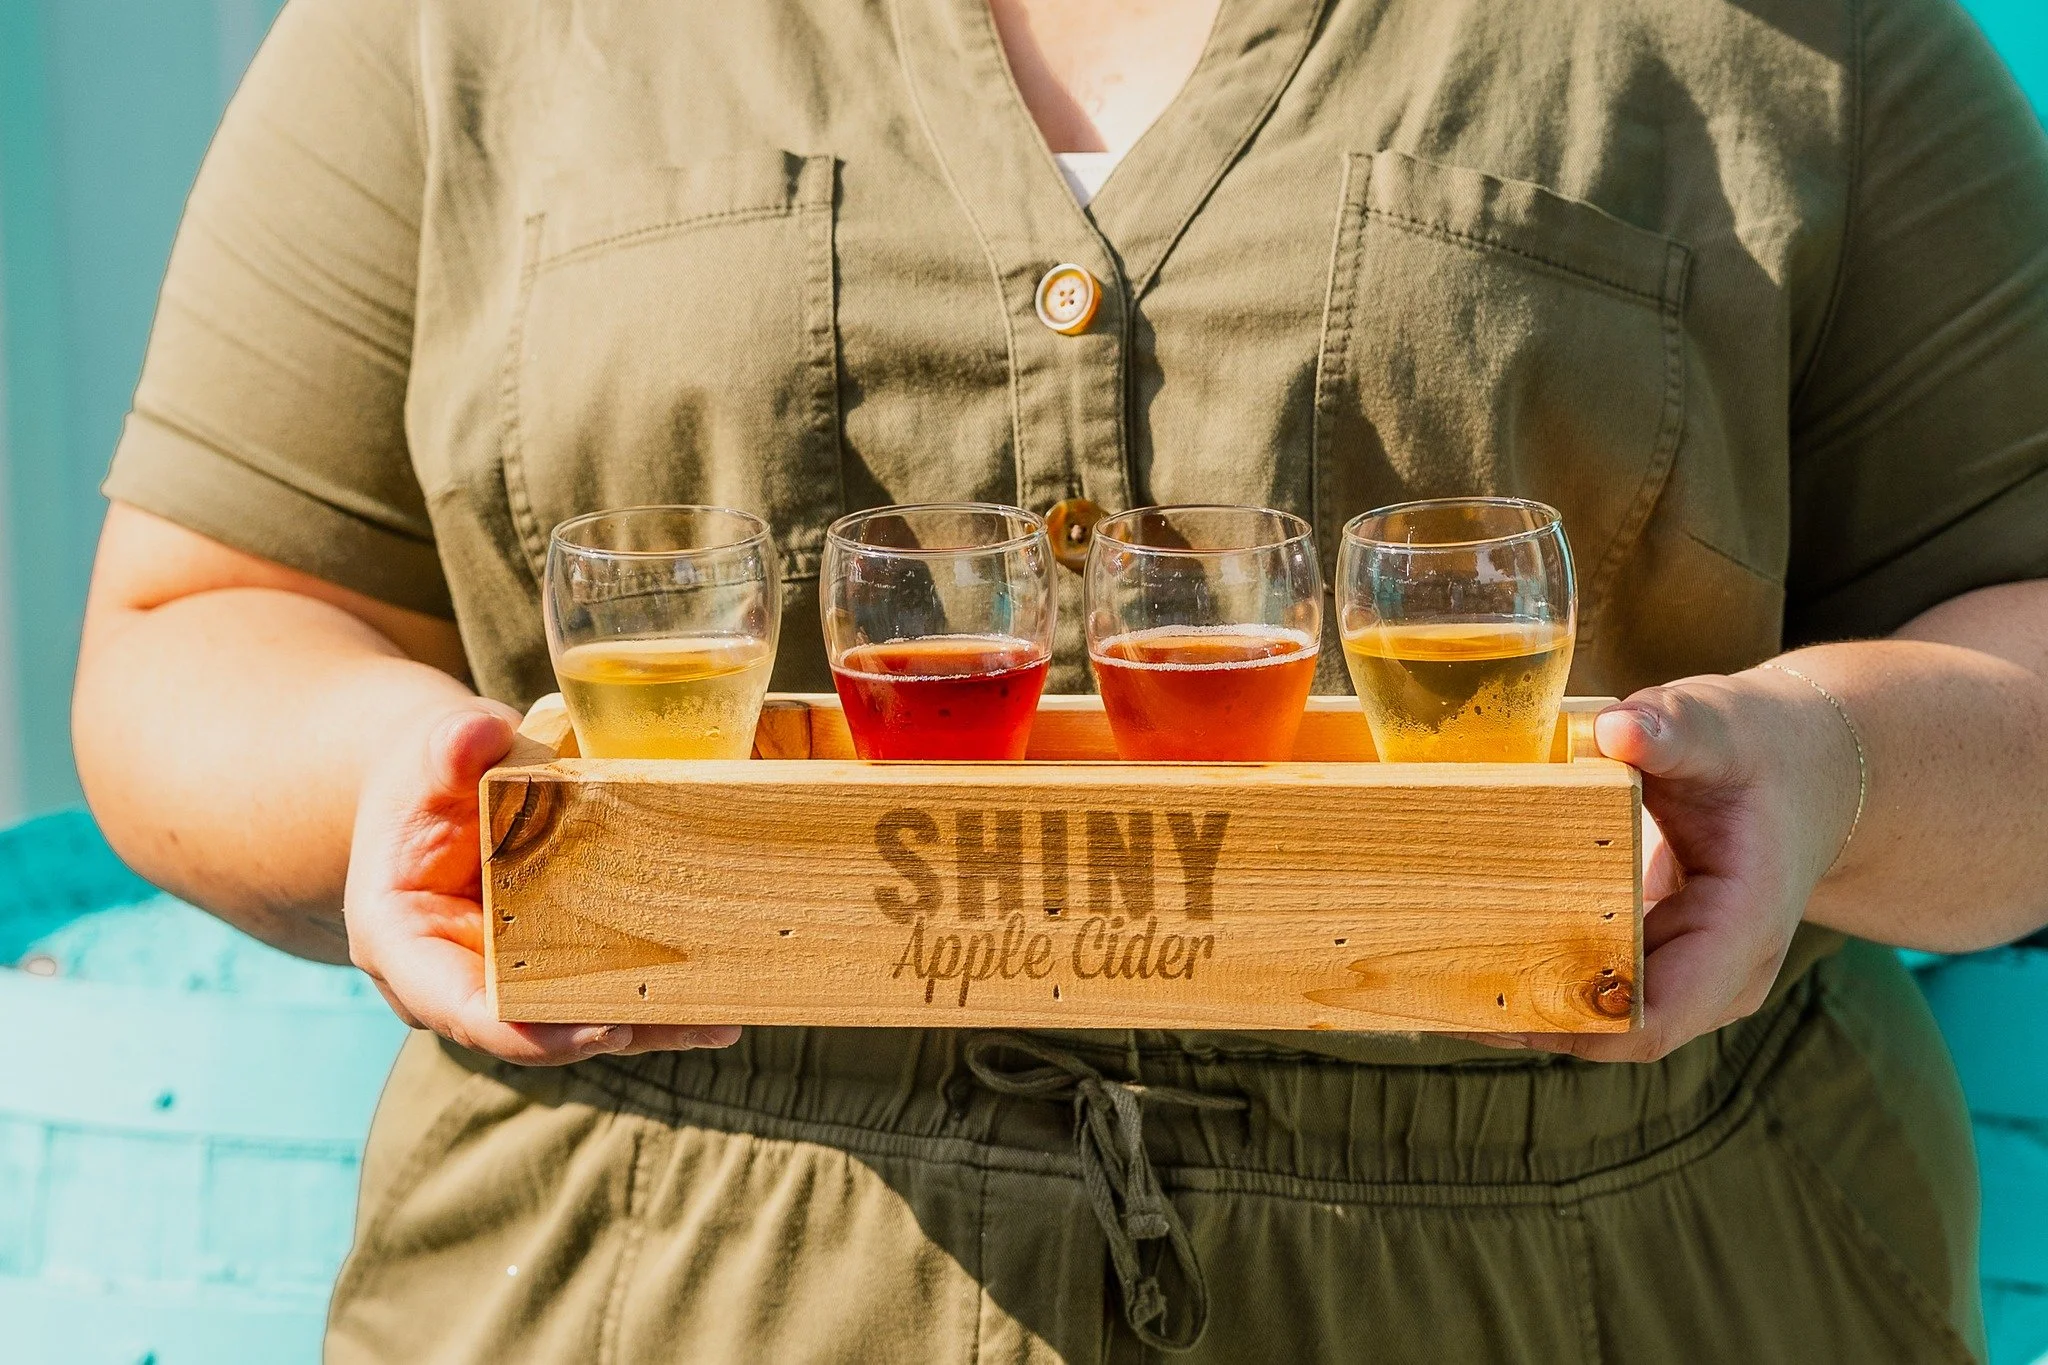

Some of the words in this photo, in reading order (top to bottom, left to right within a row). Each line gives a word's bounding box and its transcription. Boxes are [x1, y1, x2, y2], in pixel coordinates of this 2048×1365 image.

[874, 808, 1231, 922] SHINY
[892, 912, 1056, 1007] Apple
[1072, 915, 1214, 980] Cider
